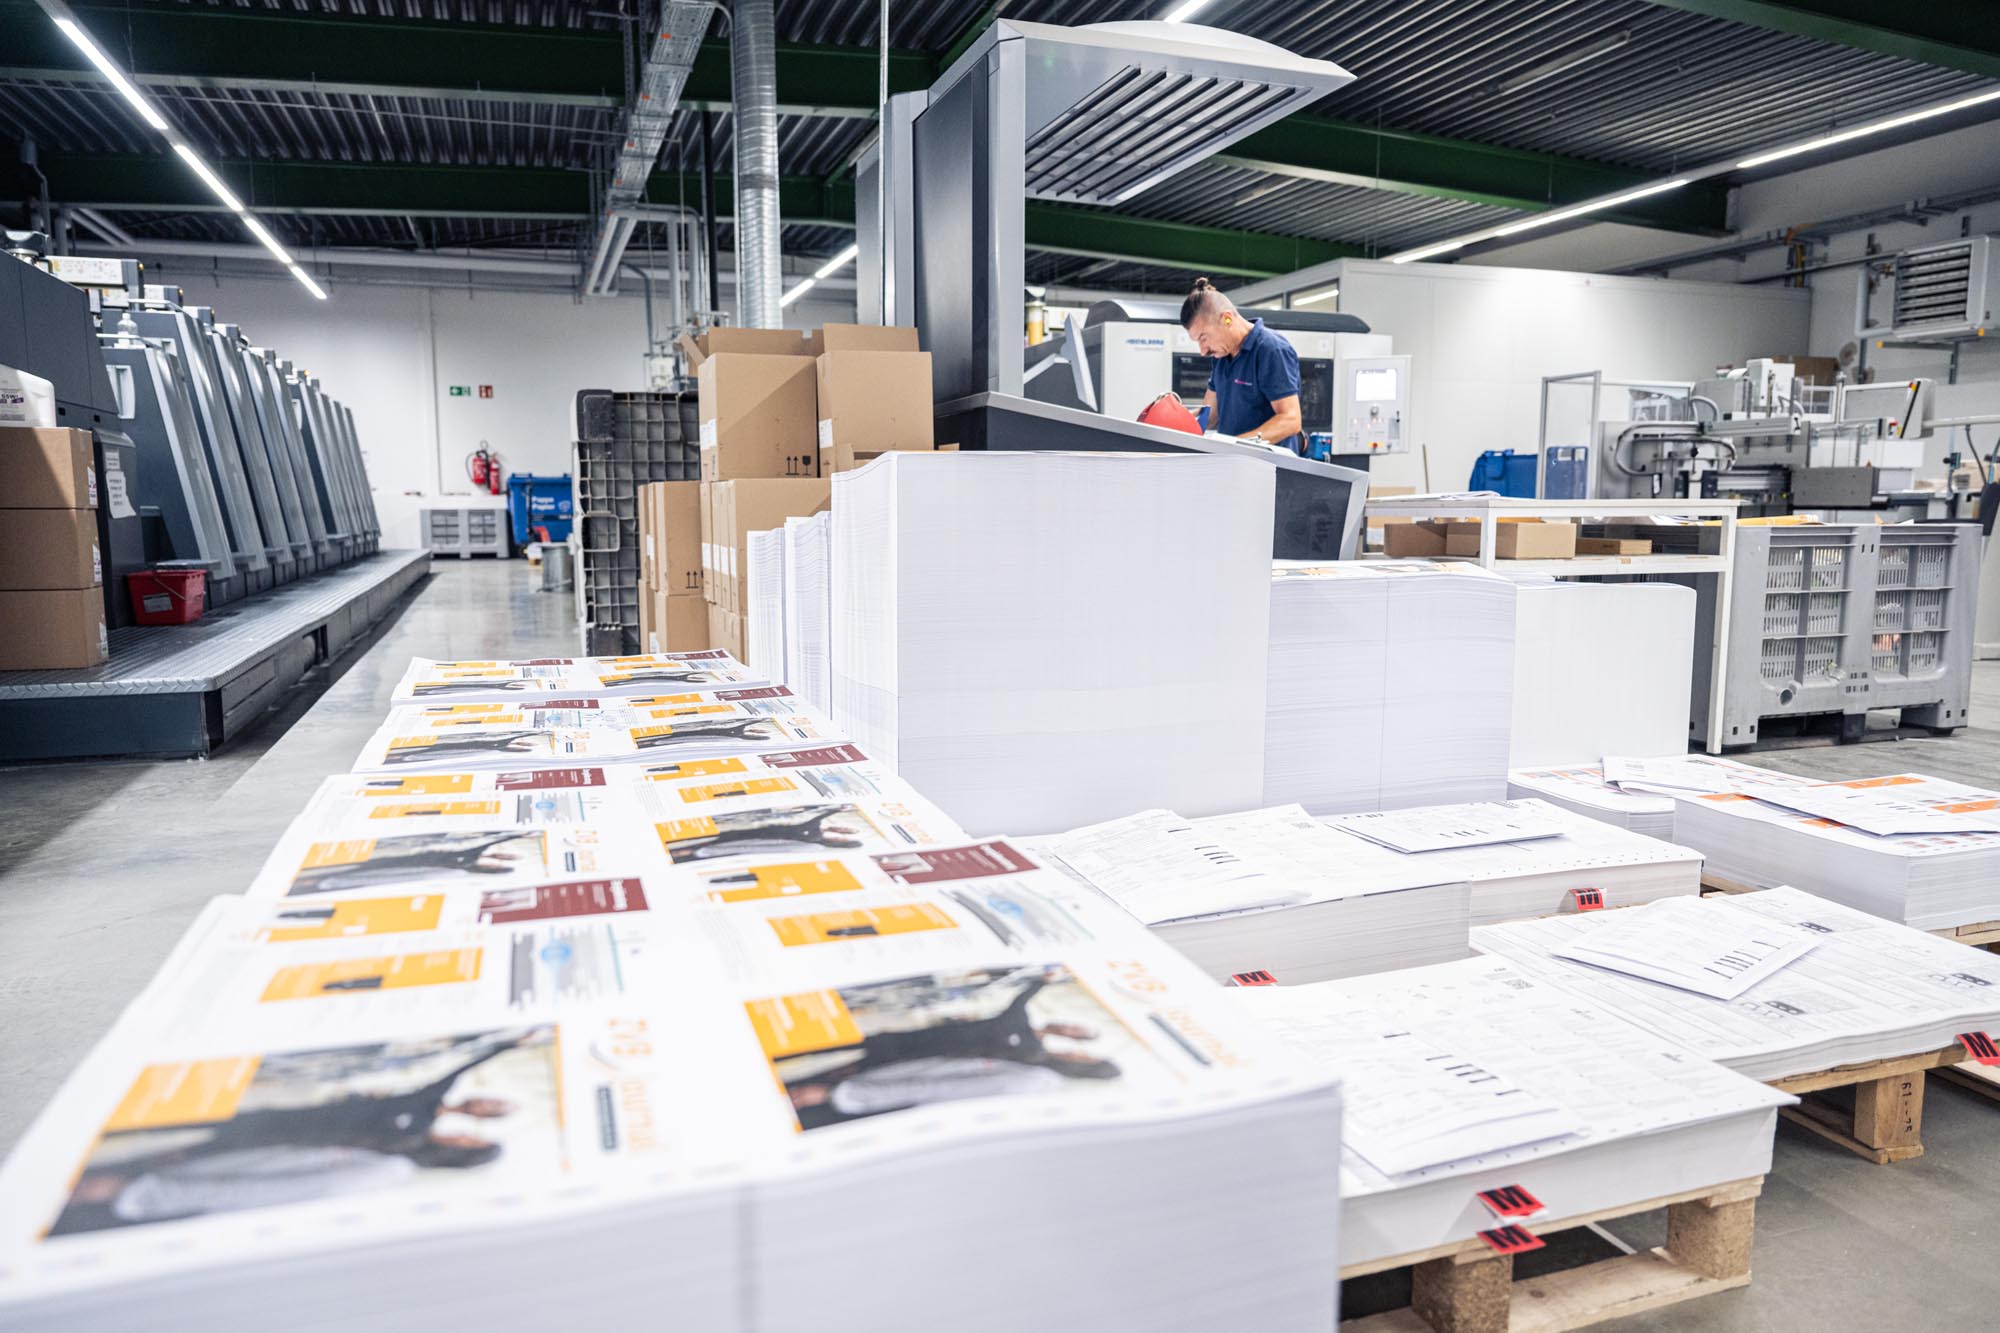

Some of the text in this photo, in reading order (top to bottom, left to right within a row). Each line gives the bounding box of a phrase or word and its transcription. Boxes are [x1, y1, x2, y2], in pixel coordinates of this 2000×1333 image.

[1961, 1032, 1999, 1057] M
[1484, 1185, 1534, 1210] M
[1484, 1225, 1532, 1248] M
